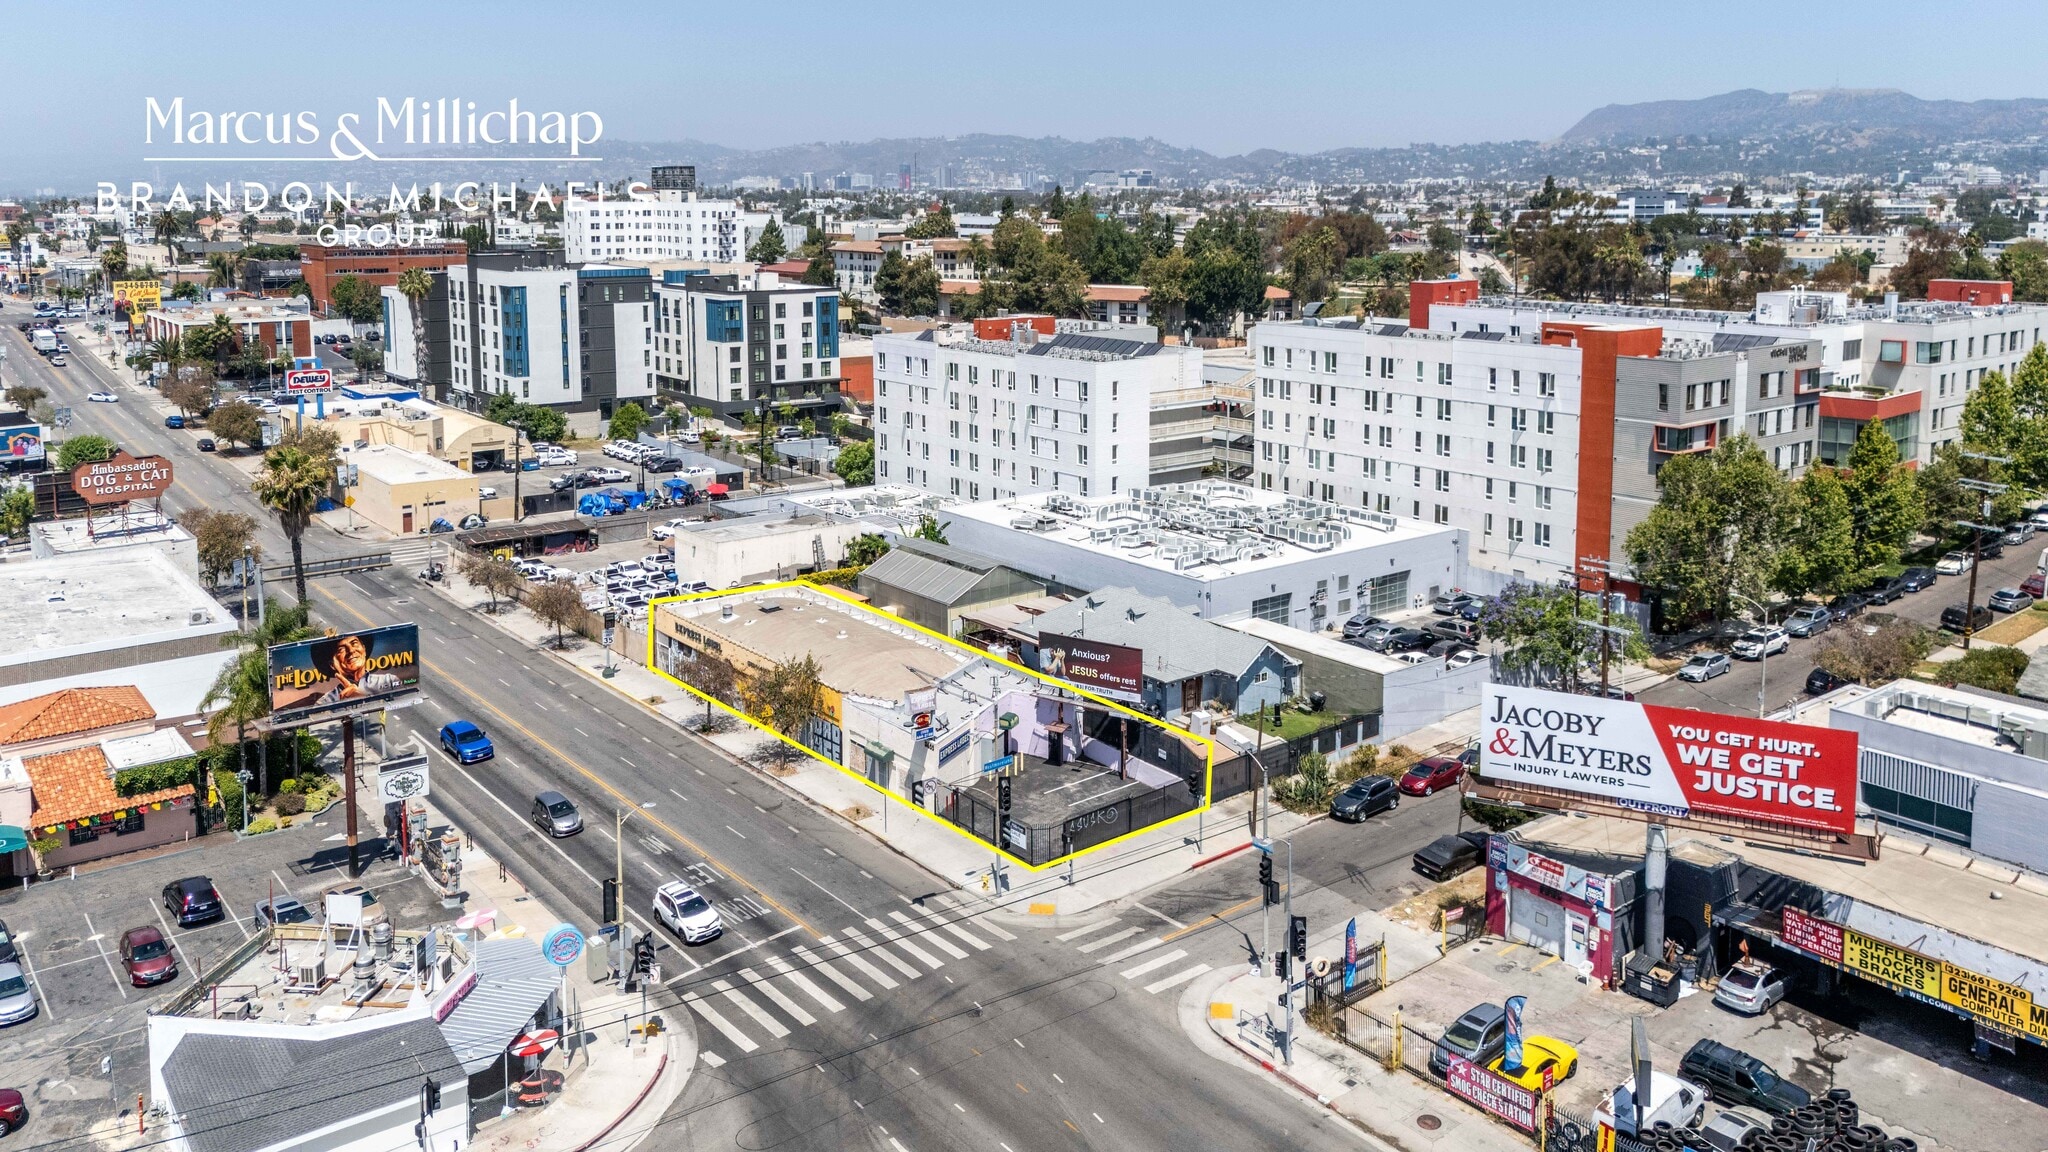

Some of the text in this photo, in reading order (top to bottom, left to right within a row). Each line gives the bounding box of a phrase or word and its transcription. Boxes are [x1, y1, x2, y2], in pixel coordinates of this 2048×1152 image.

[293, 375, 326, 384] DEWEY
[81, 468, 170, 488] DOG & CAT
[90, 460, 158, 475] Ambassador
[96, 482, 157, 496] HOSPITAL
[1071, 648, 1111, 662] Anxious?
[275, 672, 294, 689] THE
[365, 650, 413, 672] DOWN
[1069, 664, 1137, 686] JESUS offers rest
[1490, 695, 1605, 737] JACOBY
[1668, 724, 1821, 758] YOU GET HURT.
[1513, 762, 1625, 787] INJURY LAWYERS
[1676, 742, 1804, 781] WE GET
[1693, 769, 1843, 812] JUSTICE.
[1619, 798, 1685, 816] OUTFRONT
[1785, 911, 1839, 937] OIL CHANGE
[1785, 918, 1842, 944] WATER PUMP
[1785, 926, 1843, 952] TIMING BELT
[1785, 933, 1841, 959] SUSPENSION
[1850, 934, 1935, 973] MUFFLERS
[1859, 948, 1925, 979] SHOCKS
[1854, 967, 1888, 988] TEMPLE
[1859, 958, 1925, 990] BRAKES
[1944, 964, 2027, 1000] (323)661-9260
[1908, 990, 1954, 1013] WELCOME
[1948, 977, 2048, 1027] GENERAL M
[1961, 998, 2048, 1038] COMPUTER DIA
[1450, 1073, 1533, 1128] SMOG CHECK STATION
[1492, 1078, 1532, 1110] CERTIFIED
